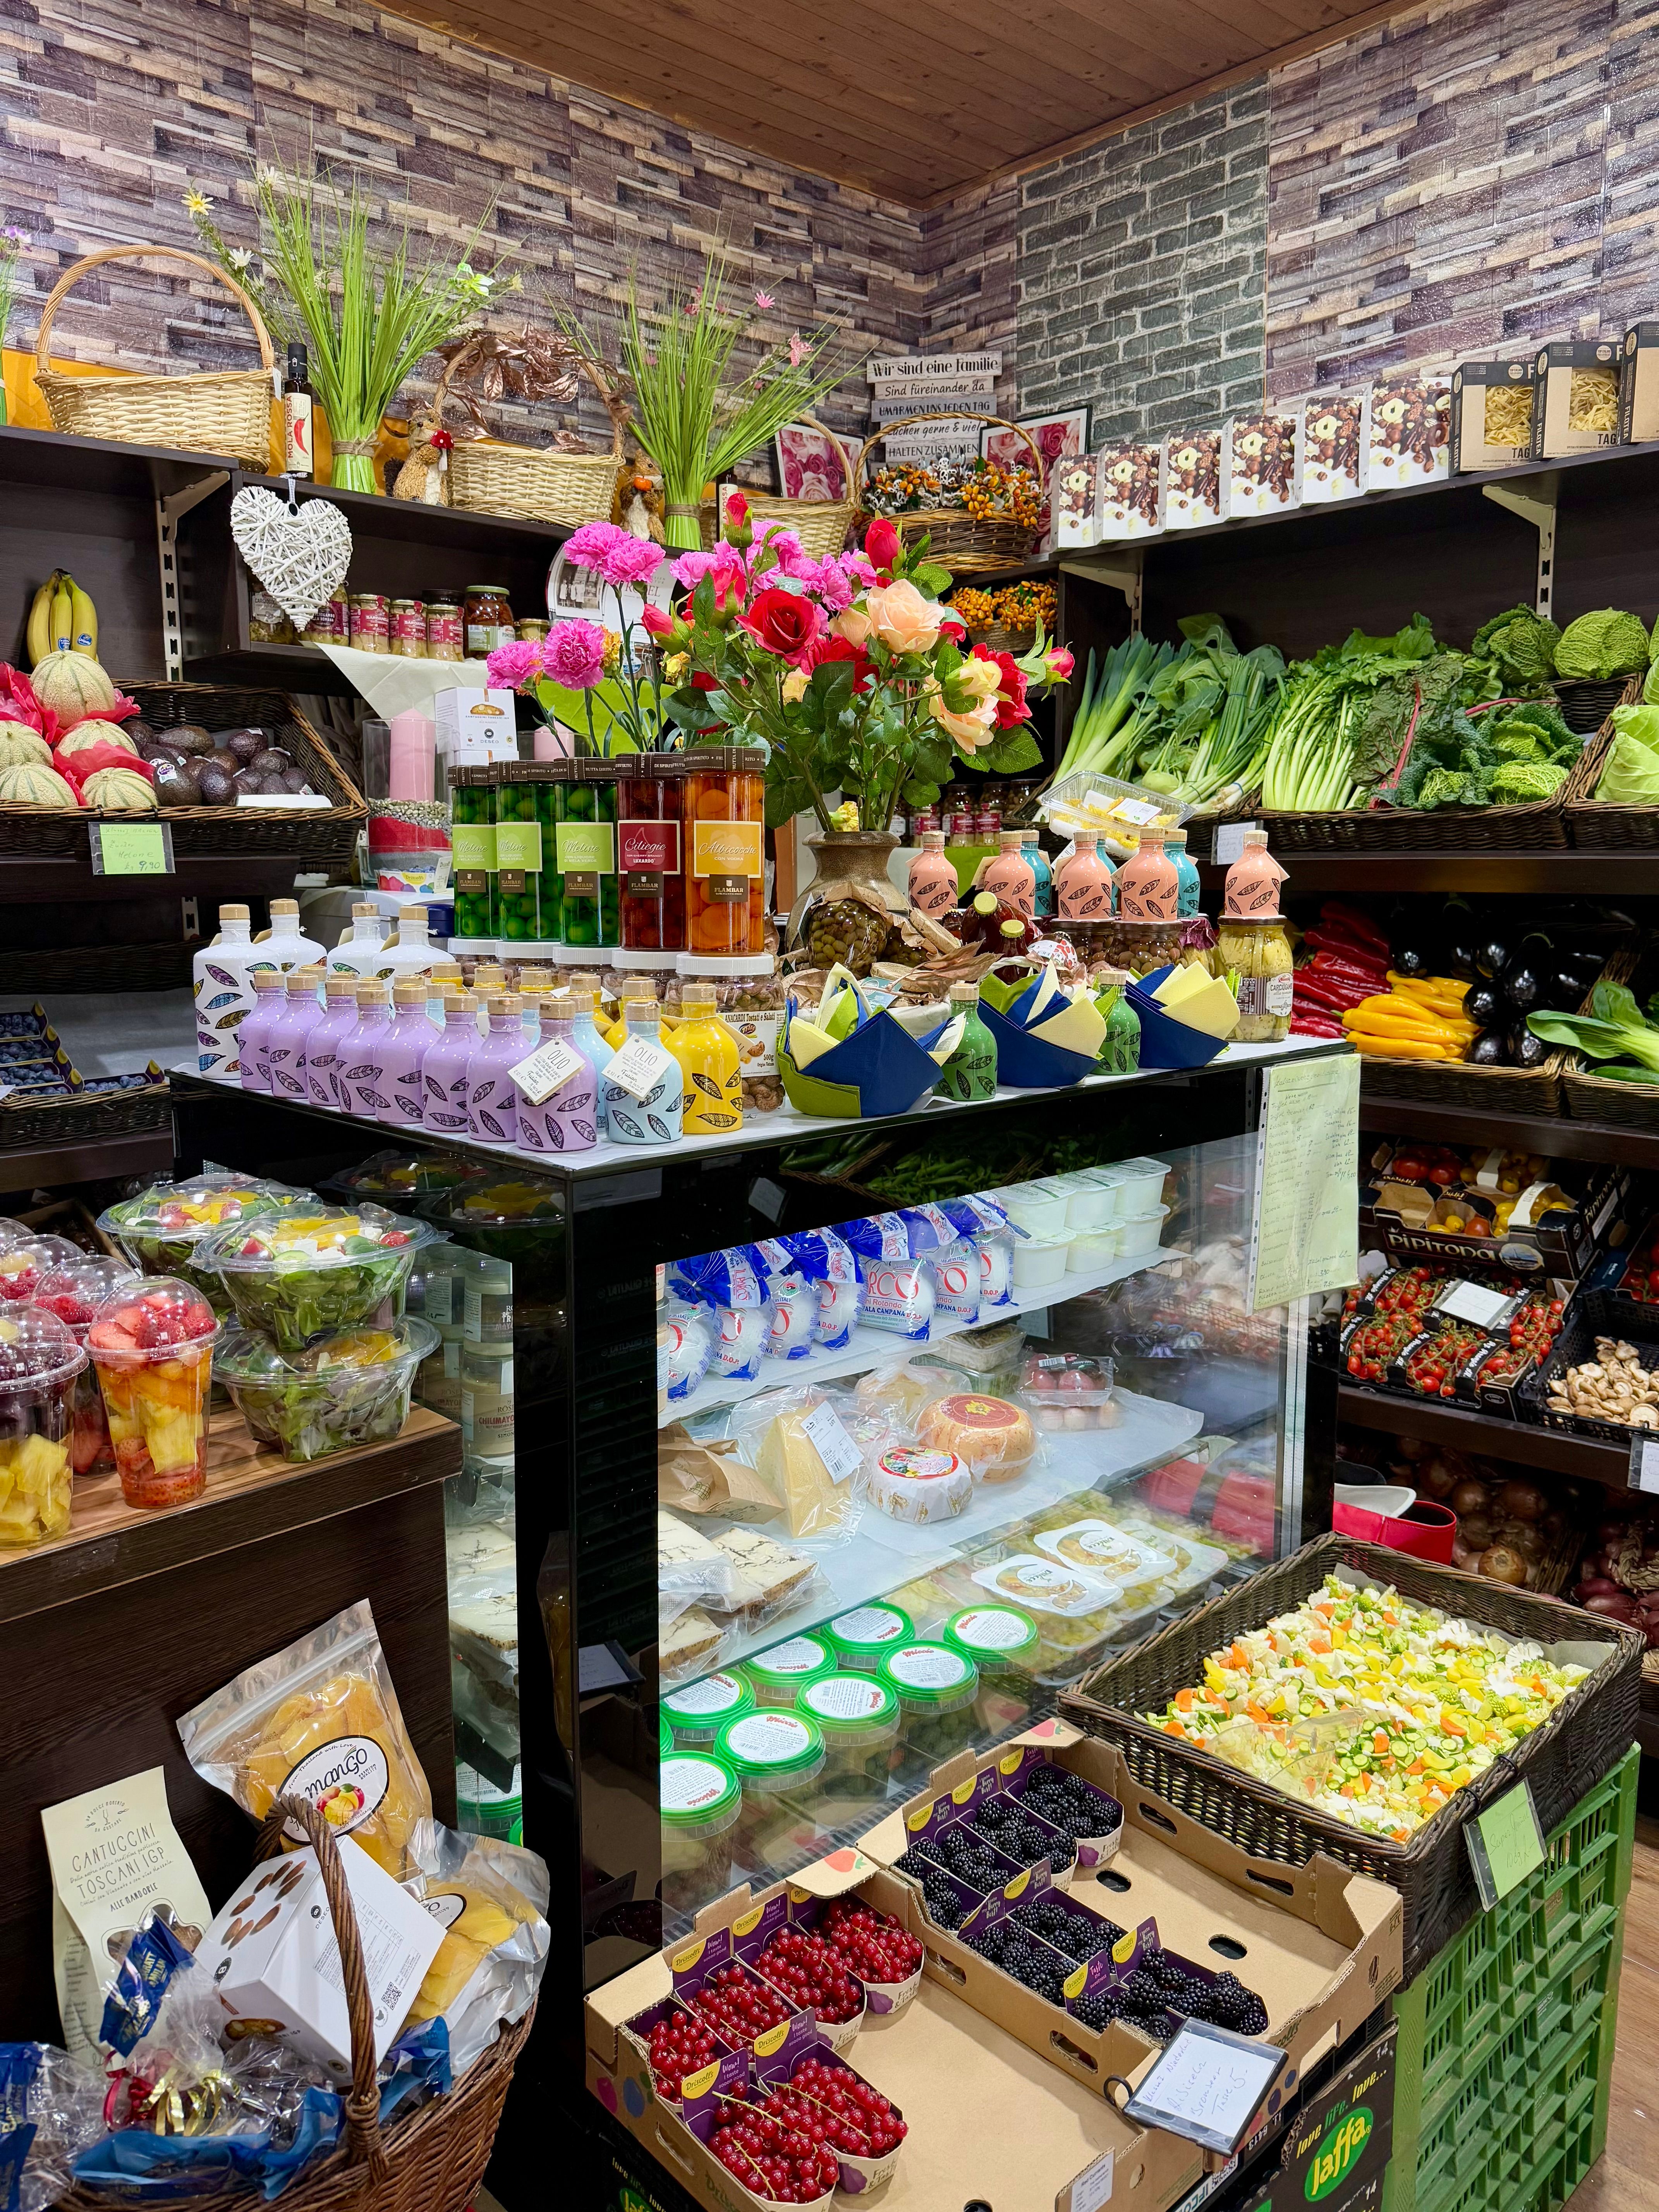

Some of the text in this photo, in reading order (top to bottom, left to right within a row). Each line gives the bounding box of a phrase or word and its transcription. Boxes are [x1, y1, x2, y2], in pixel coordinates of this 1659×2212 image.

[872, 357, 998, 377] Wir sind eine Familie
[885, 381, 984, 397] Sind füreinander da
[879, 404, 926, 416] UMARMEN
[972, 401, 990, 411] TAG
[923, 424, 949, 438] gerne
[962, 420, 981, 432] viel
[889, 443, 979, 457] HALTEN ZUSAMMEN
[456, 841, 488, 852] Meline
[498, 840, 527, 852] Meline
[562, 840, 601, 854] Meline
[625, 838, 666, 854] Ciliegie
[699, 841, 757, 855] Albicocche
[725, 1013, 745, 1023] ANACARDI
[746, 1013, 760, 1022] Tostati
[764, 1012, 775, 1021] Salati
[548, 1050, 570, 1069] OLIO
[634, 1047, 658, 1066] OLIO
[763, 1054, 774, 1062] 500g
[873, 1299, 902, 1309] Rotondo
[878, 1307, 905, 1317] CAMPANA
[936, 1304, 956, 1312] MPANA
[821, 1322, 839, 1331] D.O.P.
[722, 1355, 740, 1365] D.O.P.
[1002, 1753, 1021, 1770] Driscoll's
[1025, 1755, 1042, 1767] sweetness
[289, 1772, 300, 1790] From
[299, 1750, 324, 1772] Thailand
[955, 1782, 974, 1799] Driscoll's
[90, 1803, 104, 1815] DOLCE
[910, 1809, 930, 1826] Driscoll's
[103, 1819, 122, 1831] GUSTARE
[333, 1821, 350, 1835] PRODUCT
[355, 1807, 373, 1821] THAILAND
[72, 1822, 156, 1872] CANTUCCINI
[77, 1846, 164, 1899] TOSCANI IGP
[1007, 1877, 1027, 1893] Driscoll's
[110, 1882, 158, 1912] ALLE MANDORLE
[765, 1899, 781, 1914] Wow!
[315, 1906, 330, 1930] DESEO
[735, 1913, 759, 1930] Driscoll's
[707, 1934, 723, 1949] Wow!
[1115, 1937, 1134, 1956] Driscoll's
[675, 1947, 701, 1968] Driscoll's
[1089, 1961, 1103, 1975] Taste
[1066, 1972, 1085, 1991] Driscoll's
[1089, 1974, 1107, 1989] sweetness
[792, 2015, 808, 2032] Wow!
[757, 2028, 785, 2048] Driscoll's
[722, 2056, 740, 2073] Wow!
[685, 2070, 714, 2091] Driscoll's
[1296, 2069, 1388, 2160] love life. love...
[1310, 2116, 1366, 2196] Jaffa
[1081, 2163, 1106, 2187] Red Currants
